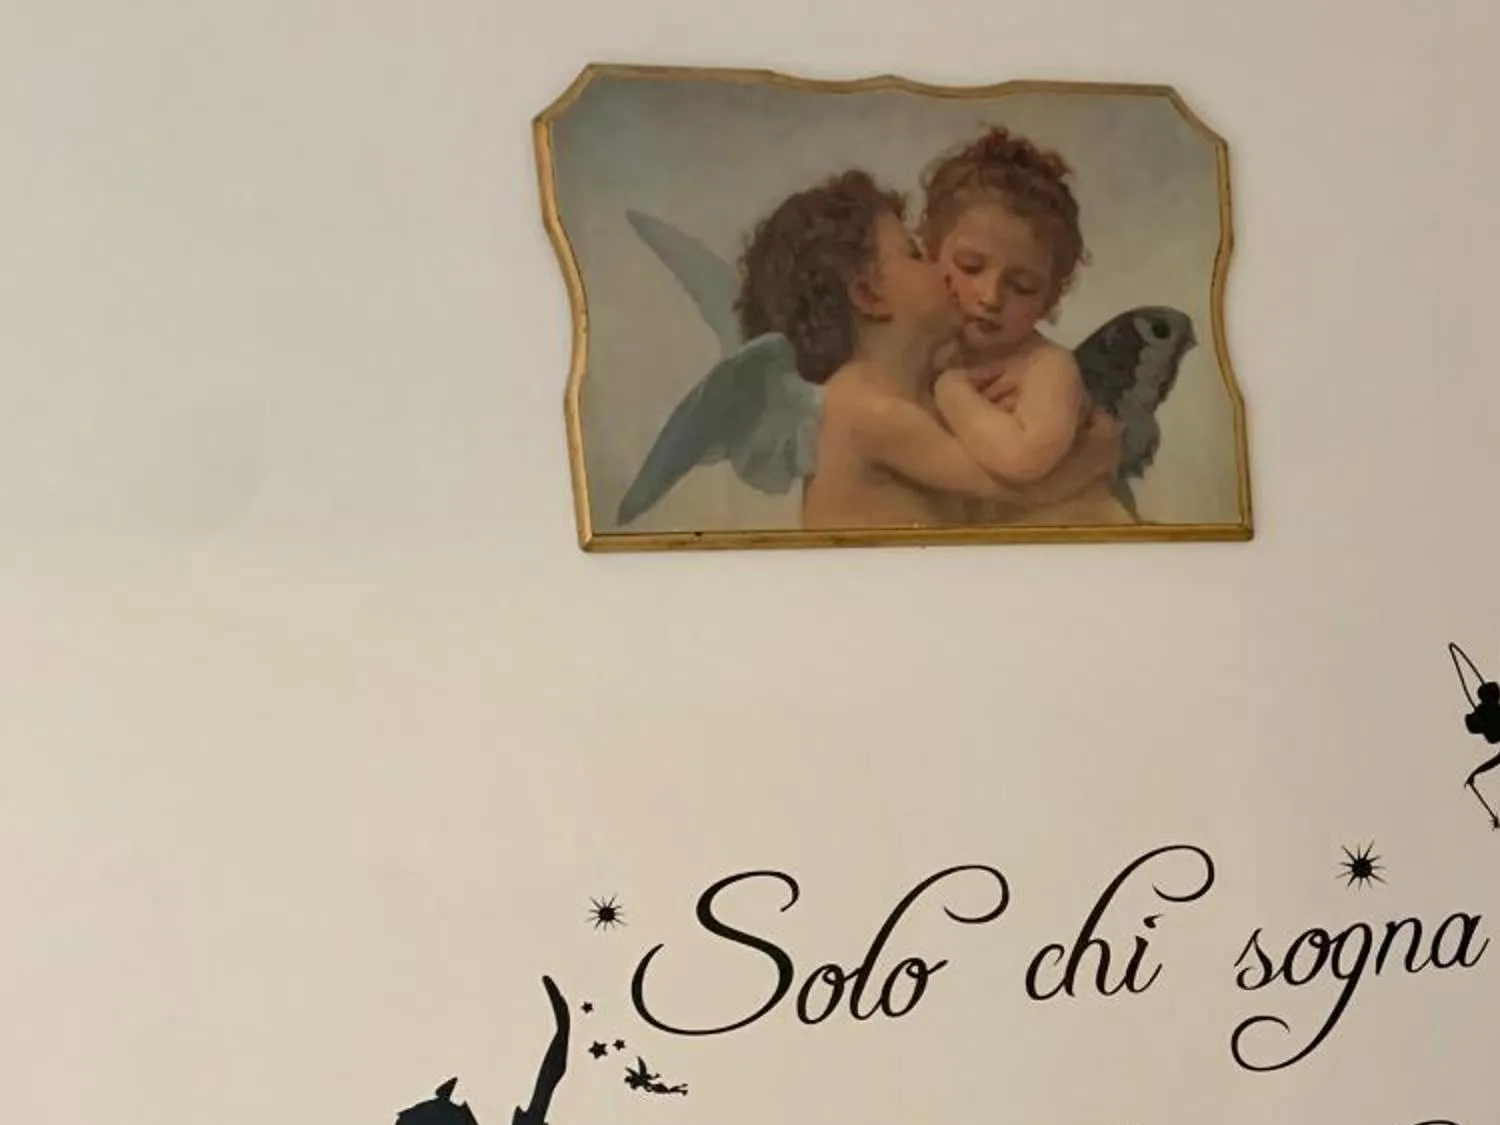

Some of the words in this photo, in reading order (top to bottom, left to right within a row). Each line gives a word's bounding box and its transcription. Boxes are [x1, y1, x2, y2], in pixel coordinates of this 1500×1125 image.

[630, 863, 1011, 1037] Solo
[1024, 843, 1216, 1002] chi
[1230, 910, 1491, 1073] sogna
